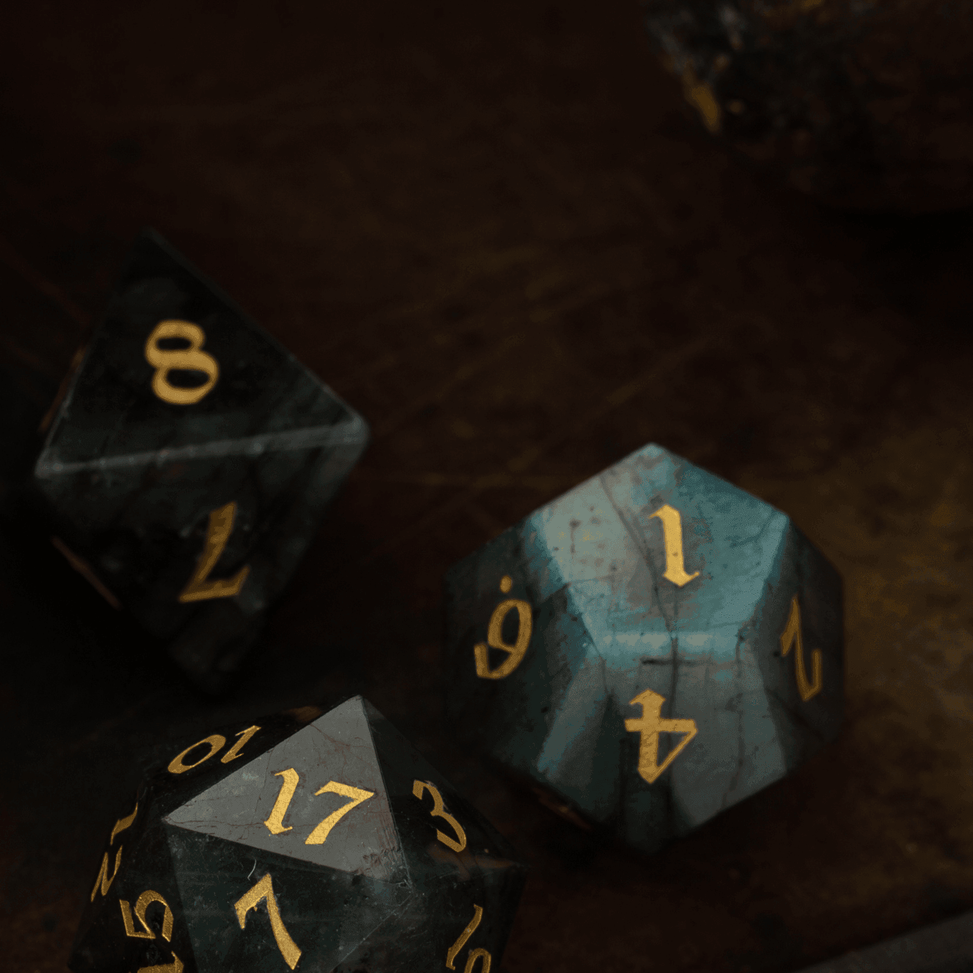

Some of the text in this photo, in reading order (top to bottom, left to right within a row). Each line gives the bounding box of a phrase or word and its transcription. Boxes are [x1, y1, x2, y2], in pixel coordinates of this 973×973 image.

[146, 320, 218, 404] 8
[180, 502, 248, 602] 7
[650, 505, 699, 586] 1
[780, 598, 822, 701] 2
[168, 725, 261, 774] 10
[625, 689, 697, 783] 4
[264, 768, 374, 845] 17
[413, 780, 467, 853] 3
[235, 874, 301, 970] 7
